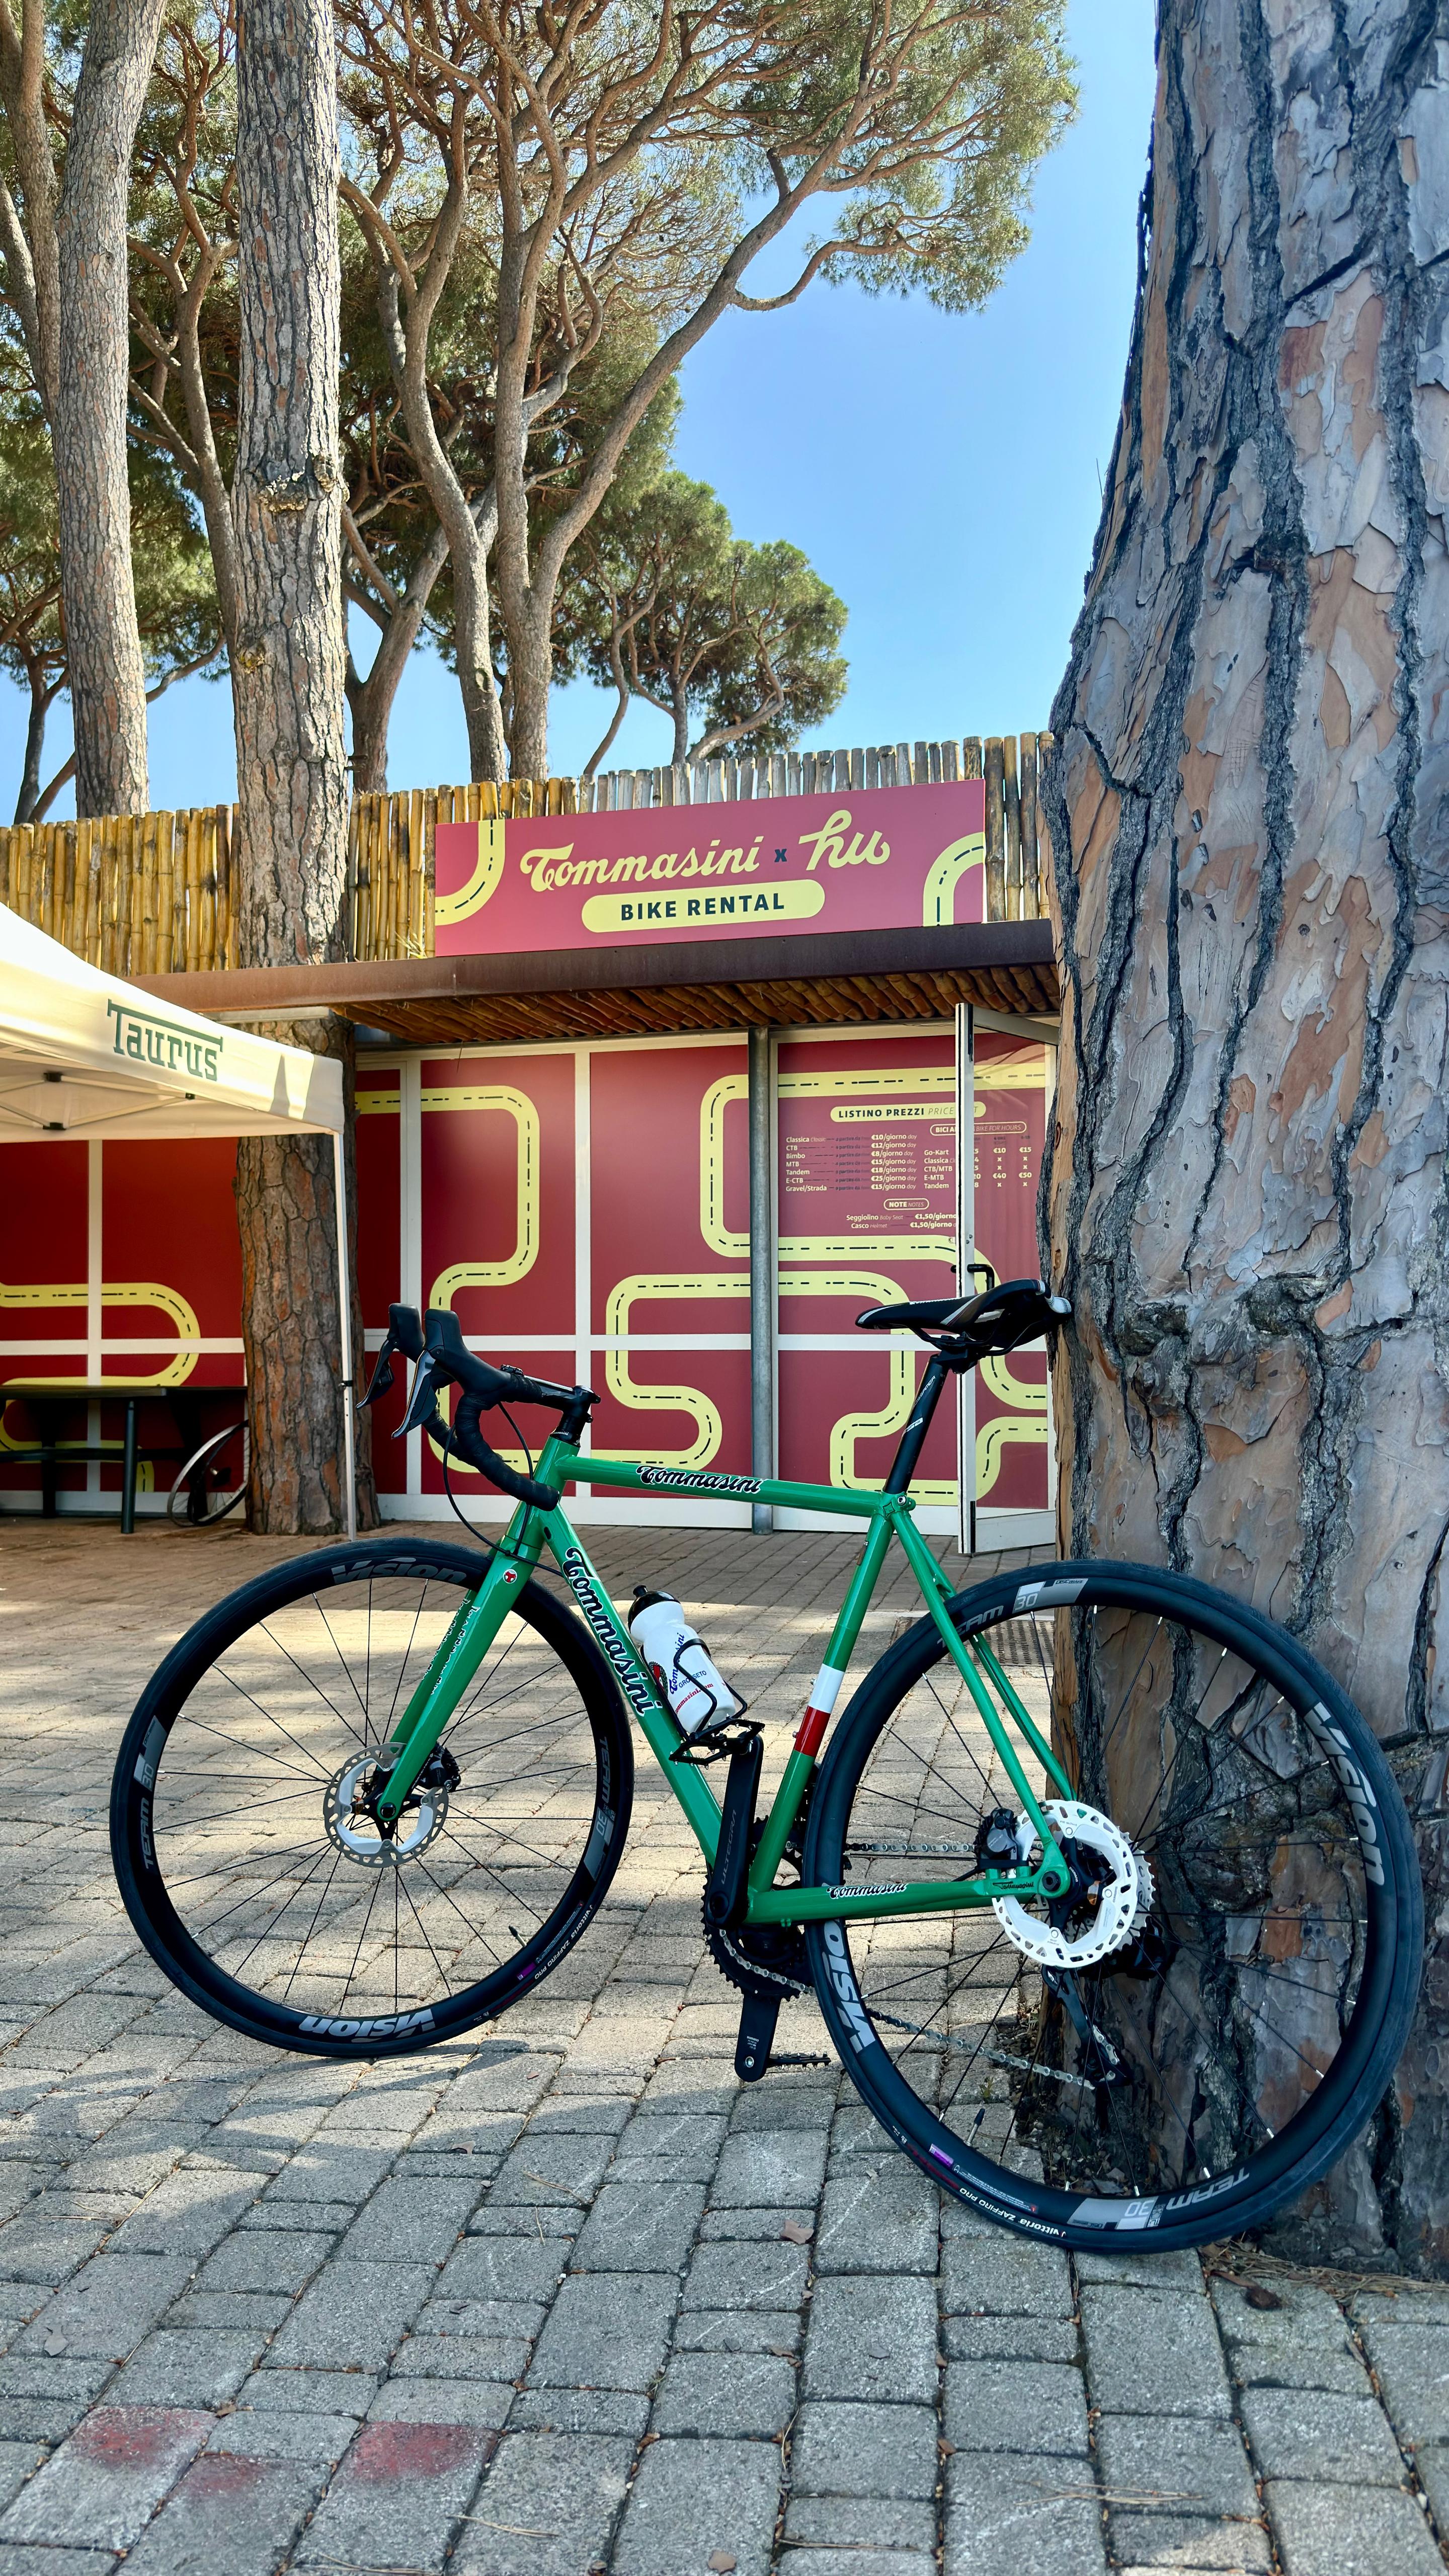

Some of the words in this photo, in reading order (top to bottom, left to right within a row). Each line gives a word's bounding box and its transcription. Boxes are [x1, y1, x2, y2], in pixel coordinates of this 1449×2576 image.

[520, 836, 764, 892] Tommasini
[774, 848, 788, 863] x
[799, 810, 892, 871] hu
[620, 900, 677, 921] BIKE
[688, 892, 785, 917] RENTAL
[107, 999, 224, 1082] Taurus
[839, 1108, 882, 1118] LISTINO
[886, 1108, 925, 1116] PREZZI
[928, 1107, 954, 1115] PRICE
[871, 1133, 907, 1141] €10/giorno
[871, 1142, 906, 1150] €12/giorno
[871, 1150, 903, 1158] €8/giorno
[871, 1166, 906, 1174] €18/giorno
[846, 1214, 878, 1222] Seggiolino
[915, 1213, 956, 1221] €1,50/giorno
[910, 1221, 952, 1229] €1,50/giorno
[912, 1375, 936, 1408] OSSAMER
[636, 1465, 768, 1494] Tommasini
[331, 1557, 467, 1585] Vision
[1015, 1593, 1038, 1611] 30
[562, 1547, 663, 1717] Tommasini
[679, 1670, 707, 1688] GROSETO
[142, 1765, 154, 1789] 30
[599, 1737, 611, 1804] TEAM
[1304, 1702, 1385, 1886] Vision
[140, 1797, 153, 1869] TEAM
[596, 1810, 607, 1836] 30
[721, 1810, 736, 1884] ULTEGRA
[826, 1883, 909, 1899] Tommasini
[547, 1940, 570, 1966] ZAFFIRO
[534, 1966, 547, 1980] PRO
[822, 1920, 876, 2054] Visio
[299, 2008, 436, 2043] Vision
[959, 2188, 978, 2202] PRO
[1166, 2167, 1250, 2210] TEAM
[979, 2200, 1016, 2221] ZAFFIRO
[1124, 2200, 1155, 2217] 30
